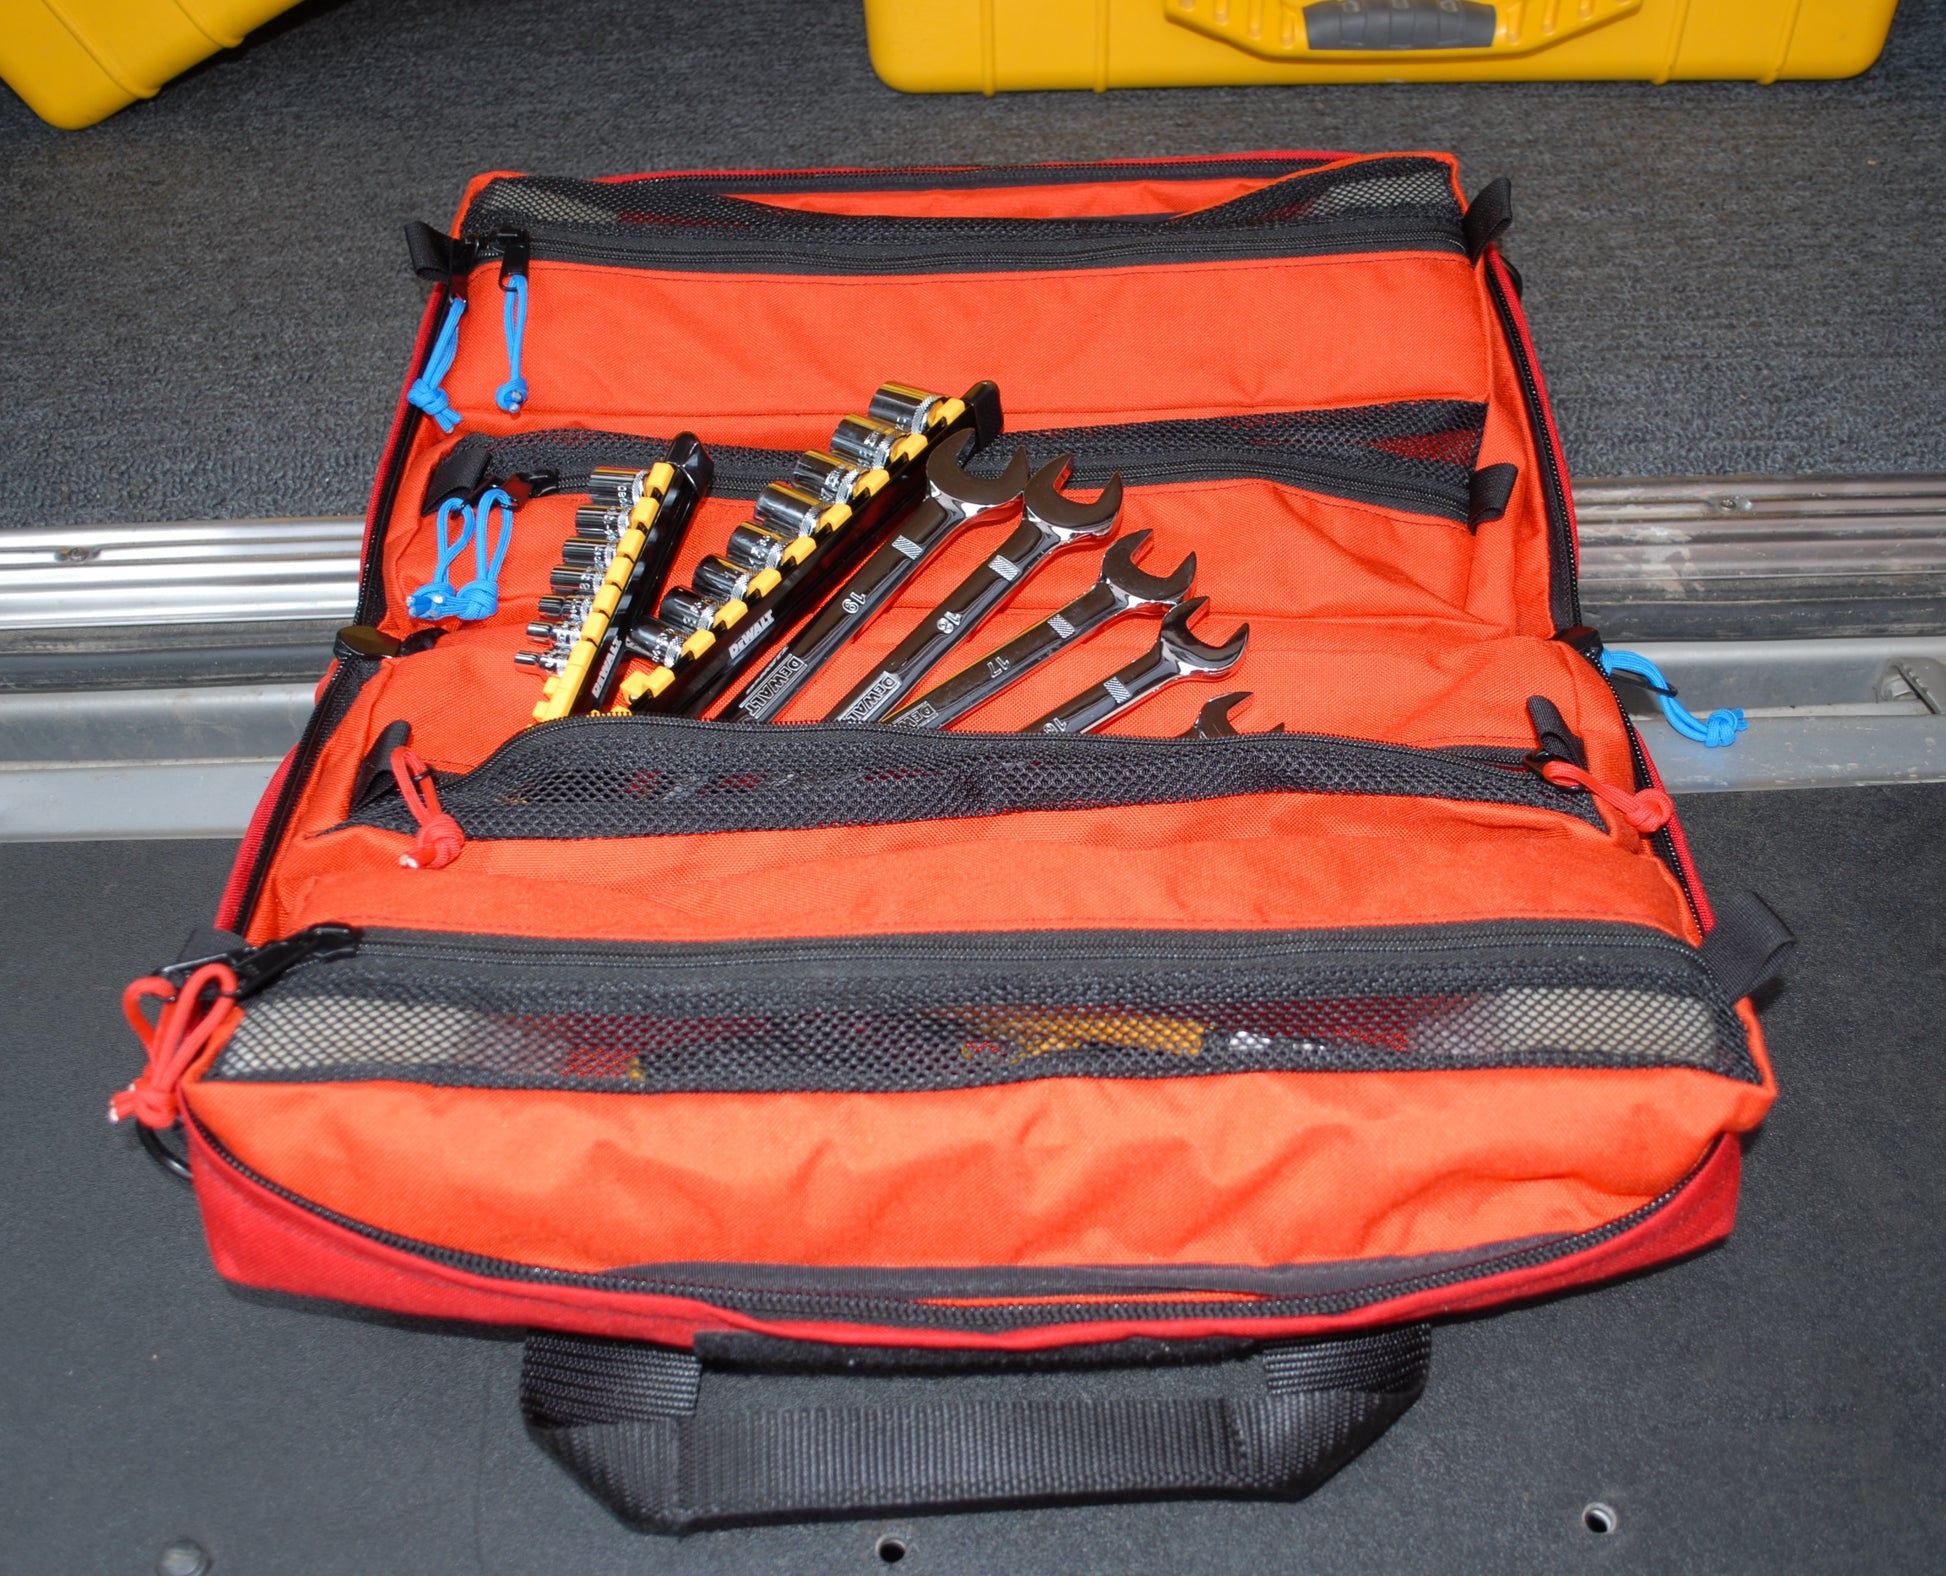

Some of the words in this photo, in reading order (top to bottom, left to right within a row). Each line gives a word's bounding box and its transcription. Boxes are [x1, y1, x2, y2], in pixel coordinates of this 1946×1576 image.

[842, 592, 867, 613] 19
[937, 611, 963, 635] 18
[728, 609, 775, 660] DEWALT
[592, 636, 622, 698] DEWALT
[745, 656, 802, 716] DEWALT
[986, 656, 1010, 679] 17
[846, 676, 896, 724] DEWAL
